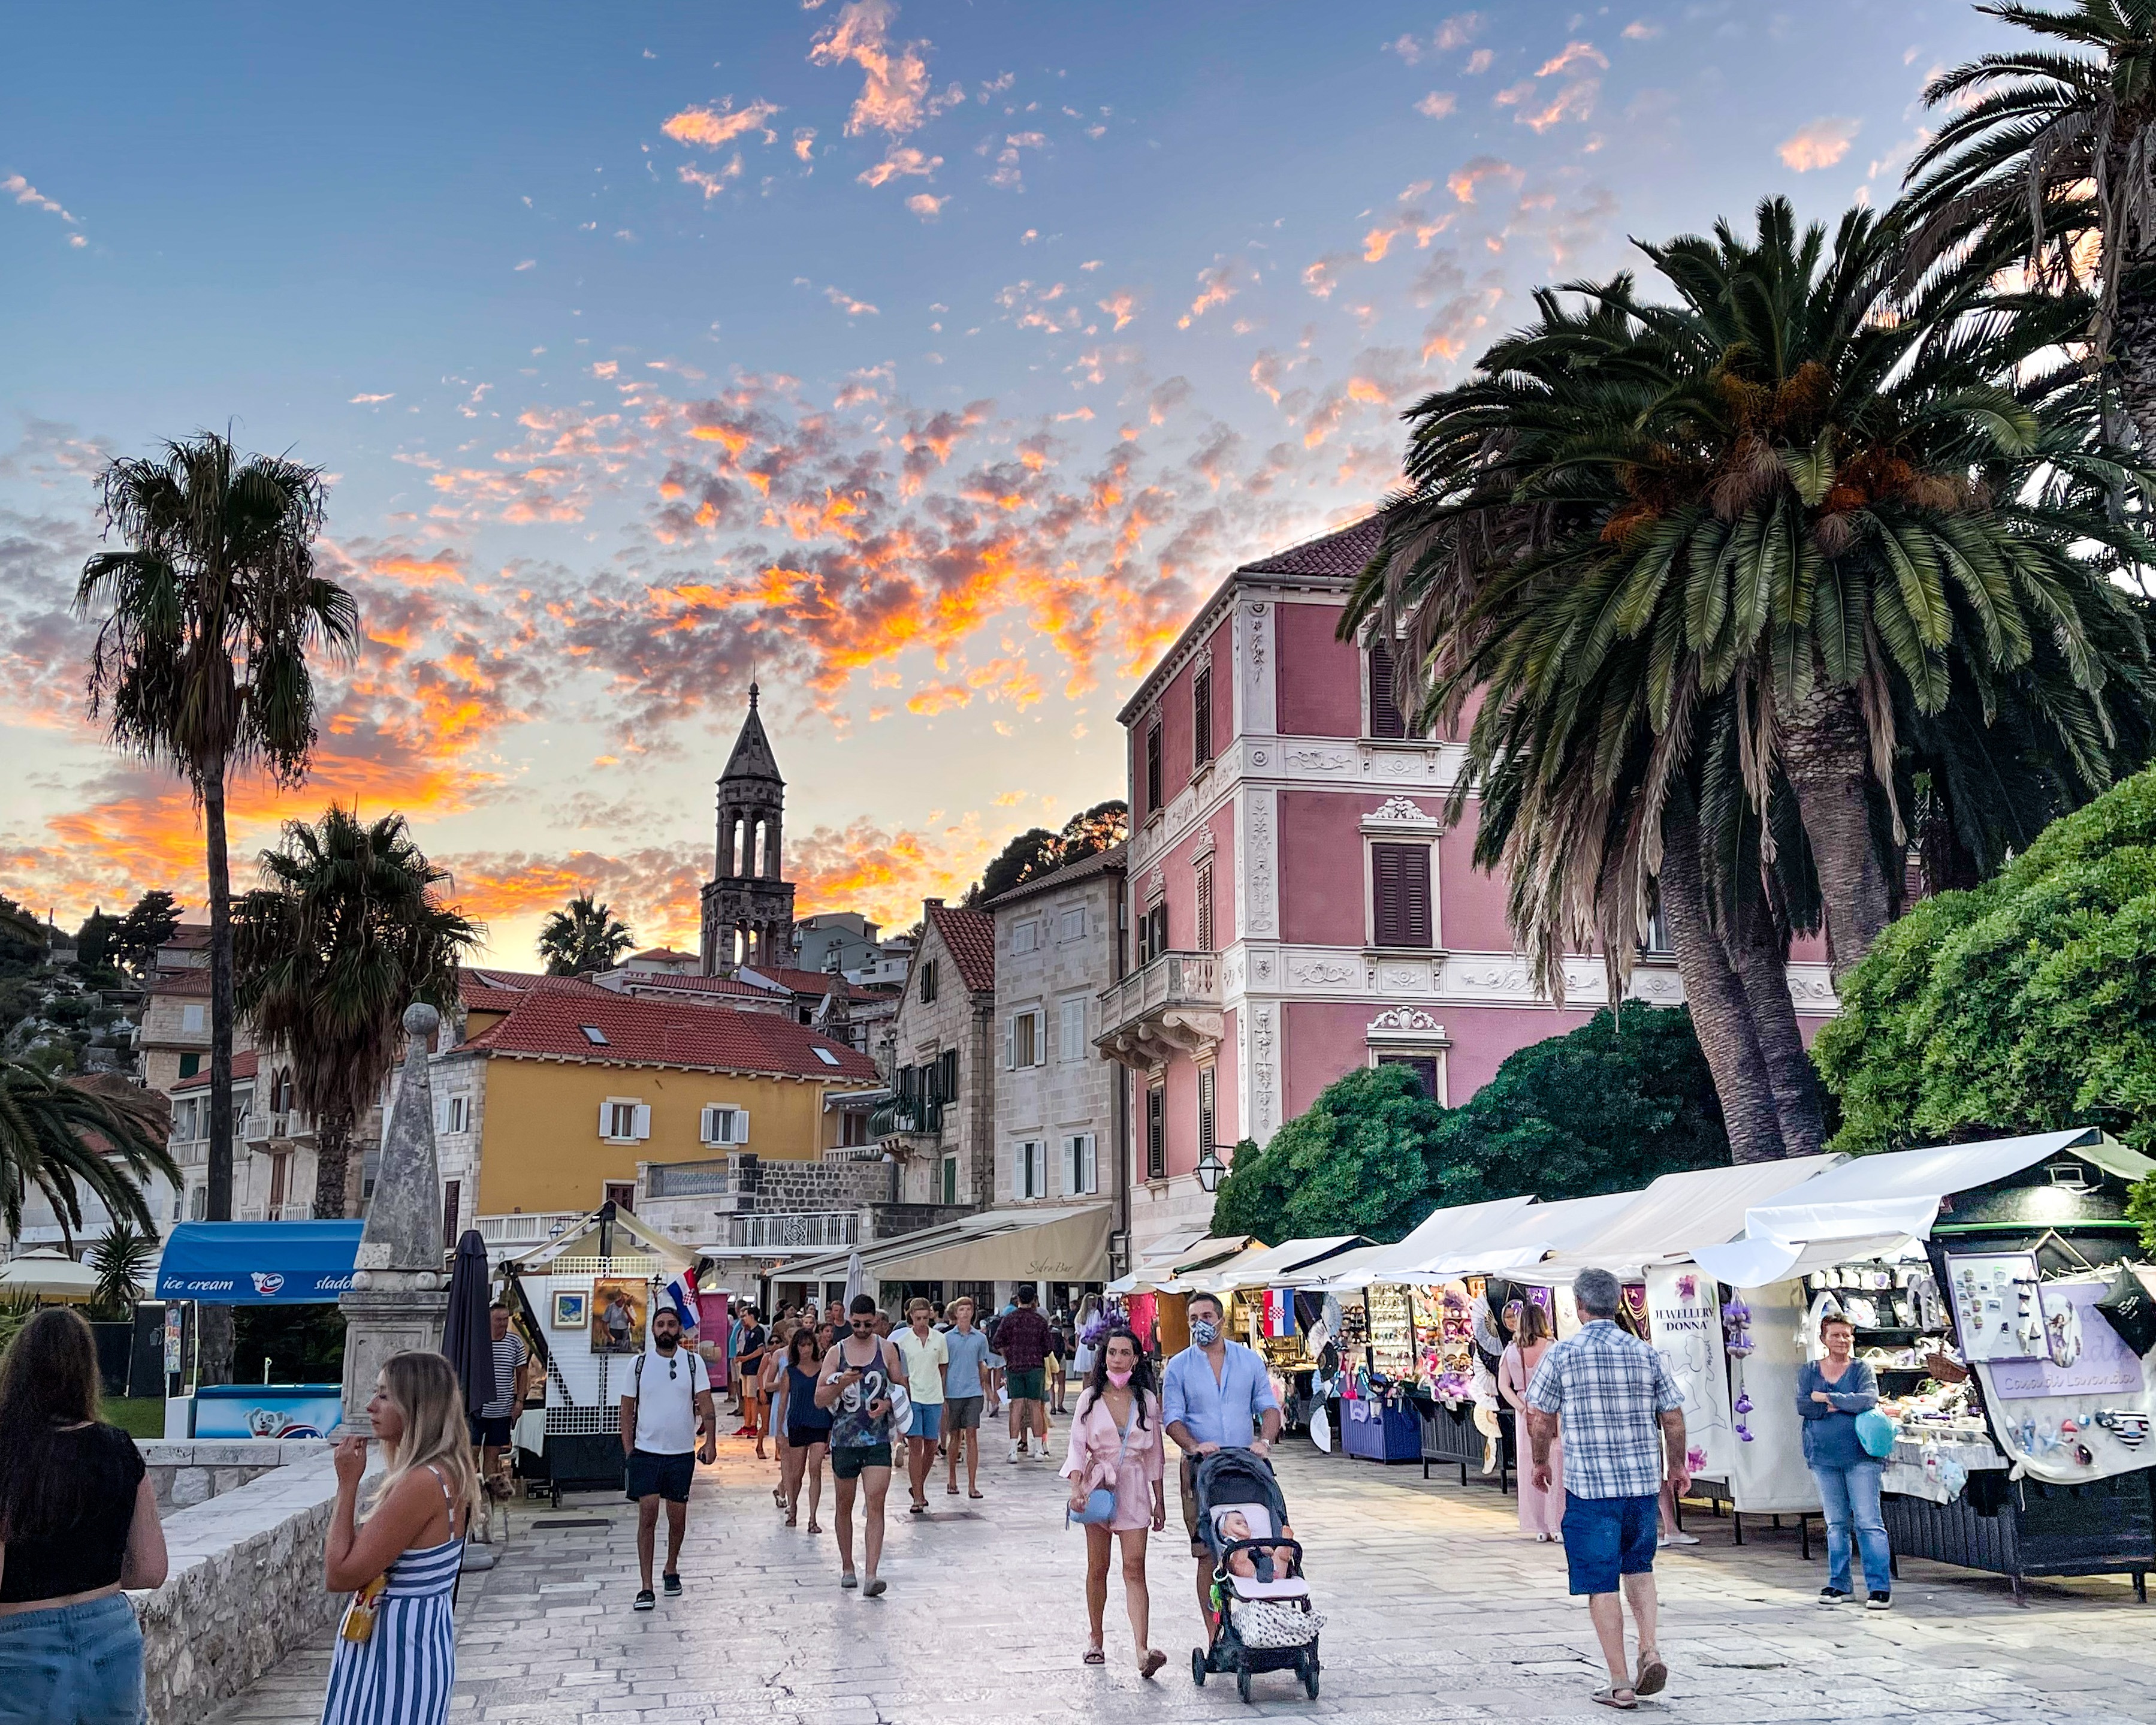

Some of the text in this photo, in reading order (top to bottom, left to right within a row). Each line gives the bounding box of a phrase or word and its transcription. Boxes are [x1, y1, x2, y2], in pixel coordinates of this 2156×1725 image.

[1055, 1262, 1073, 1272] Bar
[163, 1276, 234, 1290] ice cream
[314, 1275, 353, 1290] slado
[1654, 1307, 1714, 1320] JEWELLERY
[1663, 1320, 1708, 1331] "DONNA"
